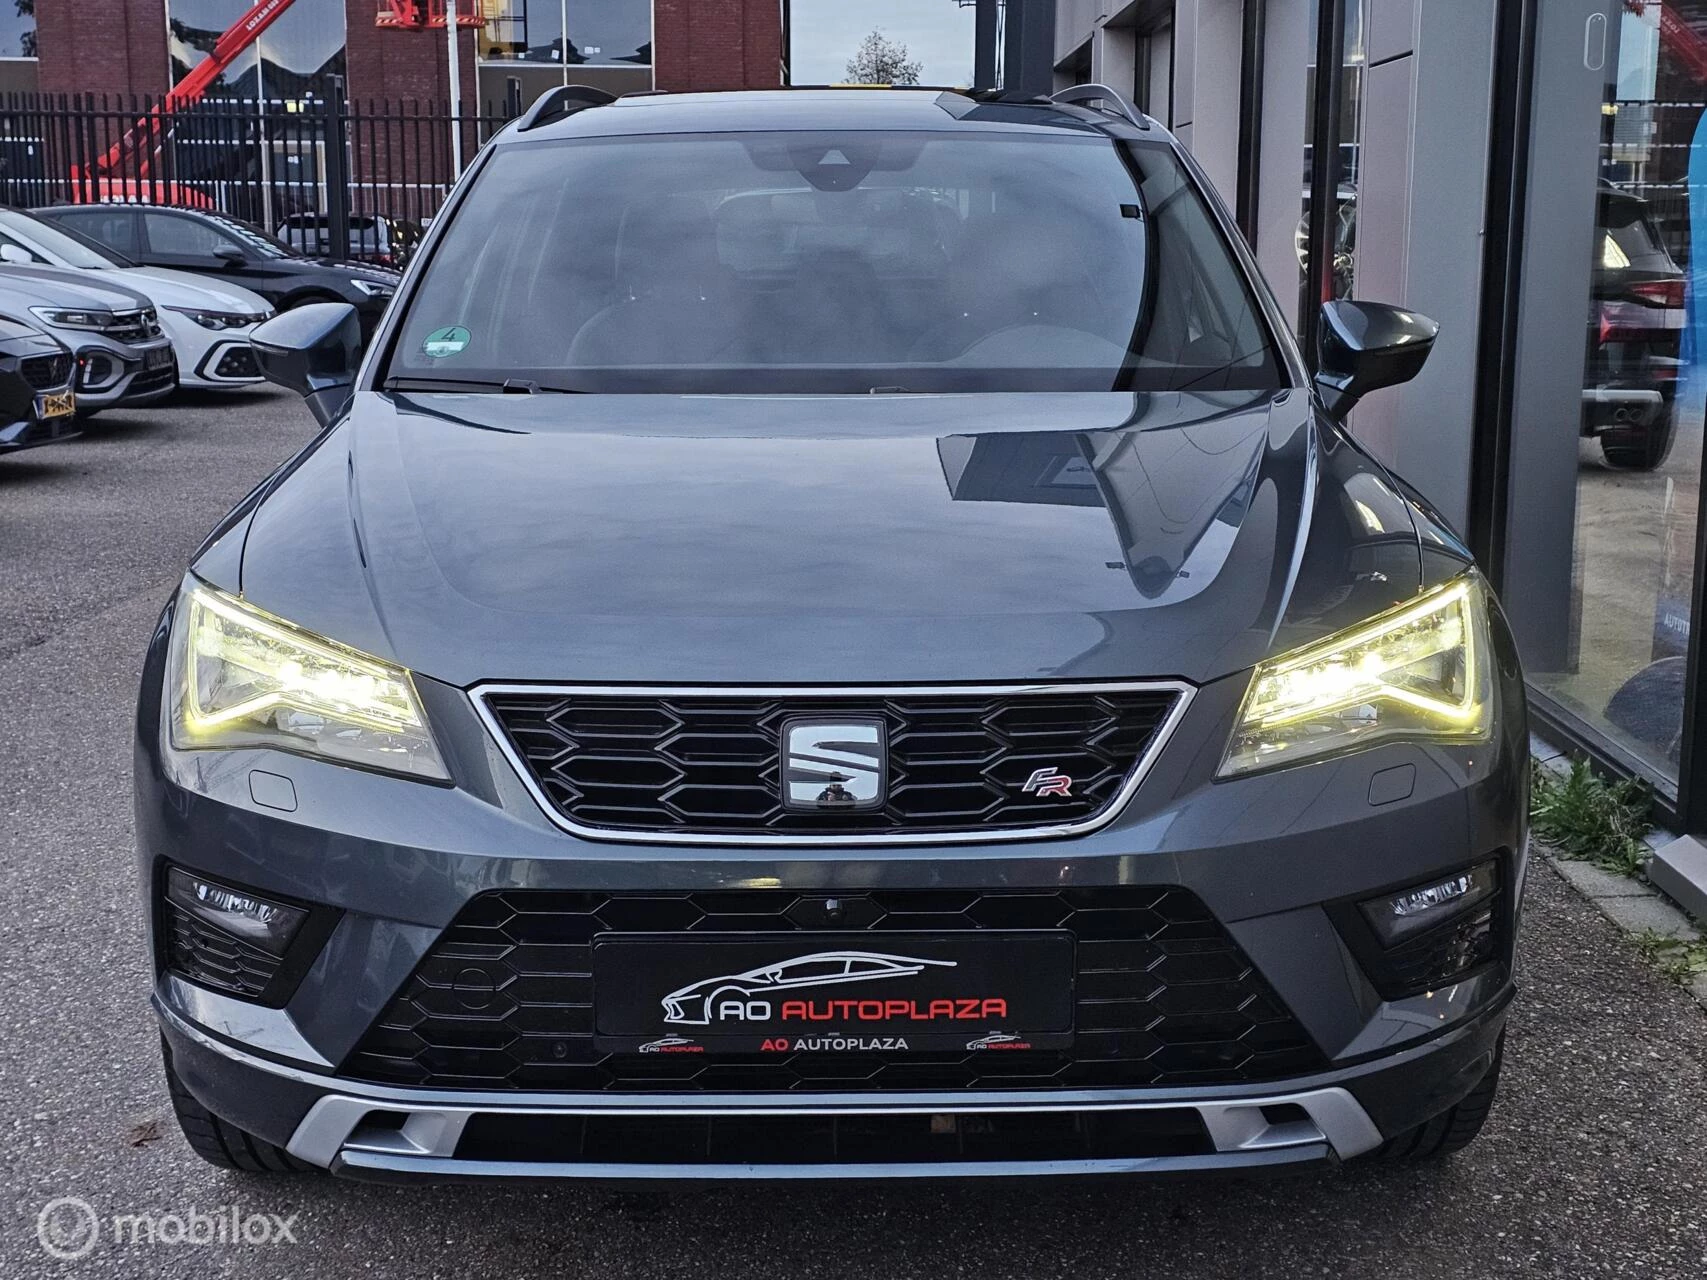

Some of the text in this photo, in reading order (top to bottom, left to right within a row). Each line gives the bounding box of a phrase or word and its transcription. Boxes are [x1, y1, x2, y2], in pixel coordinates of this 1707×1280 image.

[440, 327, 456, 342] 4
[1021, 766, 1073, 797] FR
[719, 998, 1008, 1021] AO AUTOPLAZA
[760, 1037, 909, 1051] AO AUTOPLAZA
